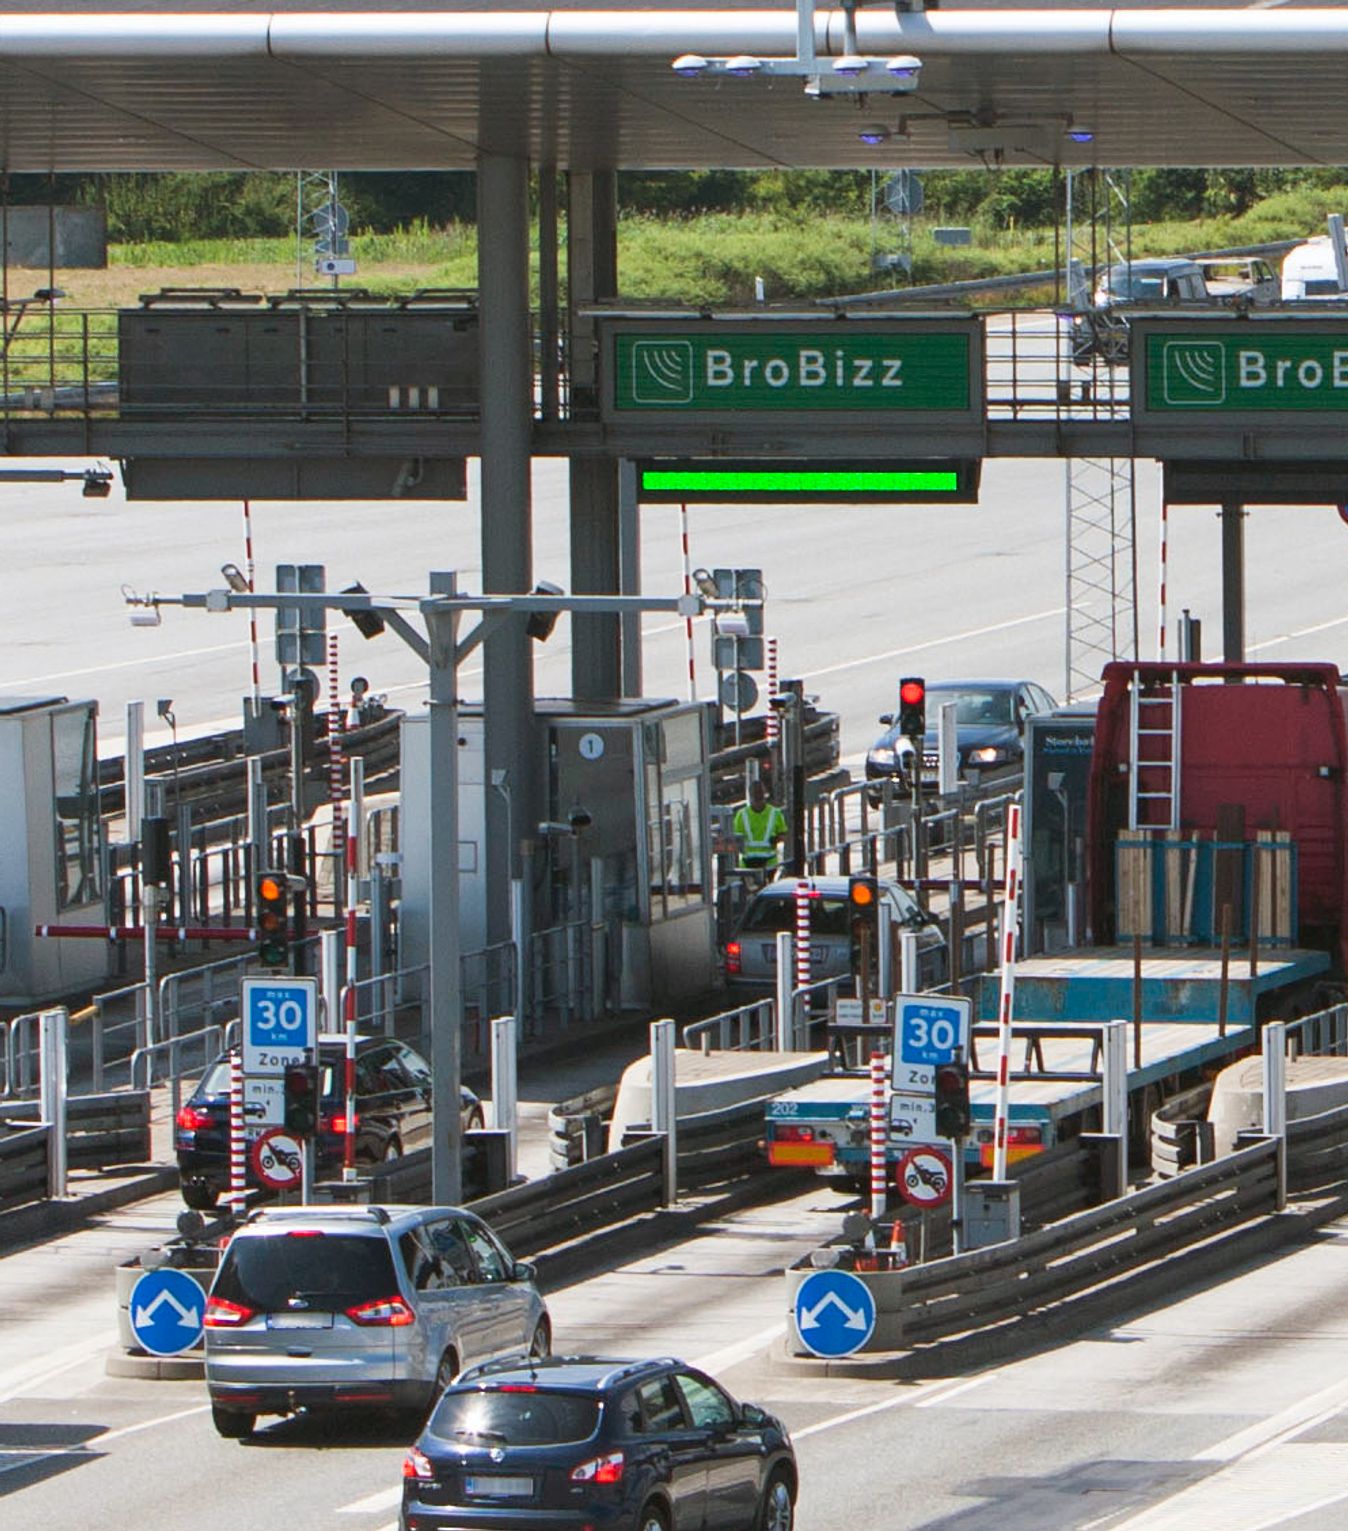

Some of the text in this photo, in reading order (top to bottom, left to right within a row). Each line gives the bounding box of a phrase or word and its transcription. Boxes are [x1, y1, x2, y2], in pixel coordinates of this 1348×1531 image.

[707, 350, 903, 386] BroBizz
[256, 1000, 302, 1030] 30
[919, 1009, 944, 1017] max
[271, 1032, 287, 1040] km
[908, 1018, 954, 1049] 30
[259, 1053, 300, 1066] Zone
[922, 1051, 938, 1059] km
[908, 1070, 935, 1085] Zo
[771, 1103, 798, 1115] 202
